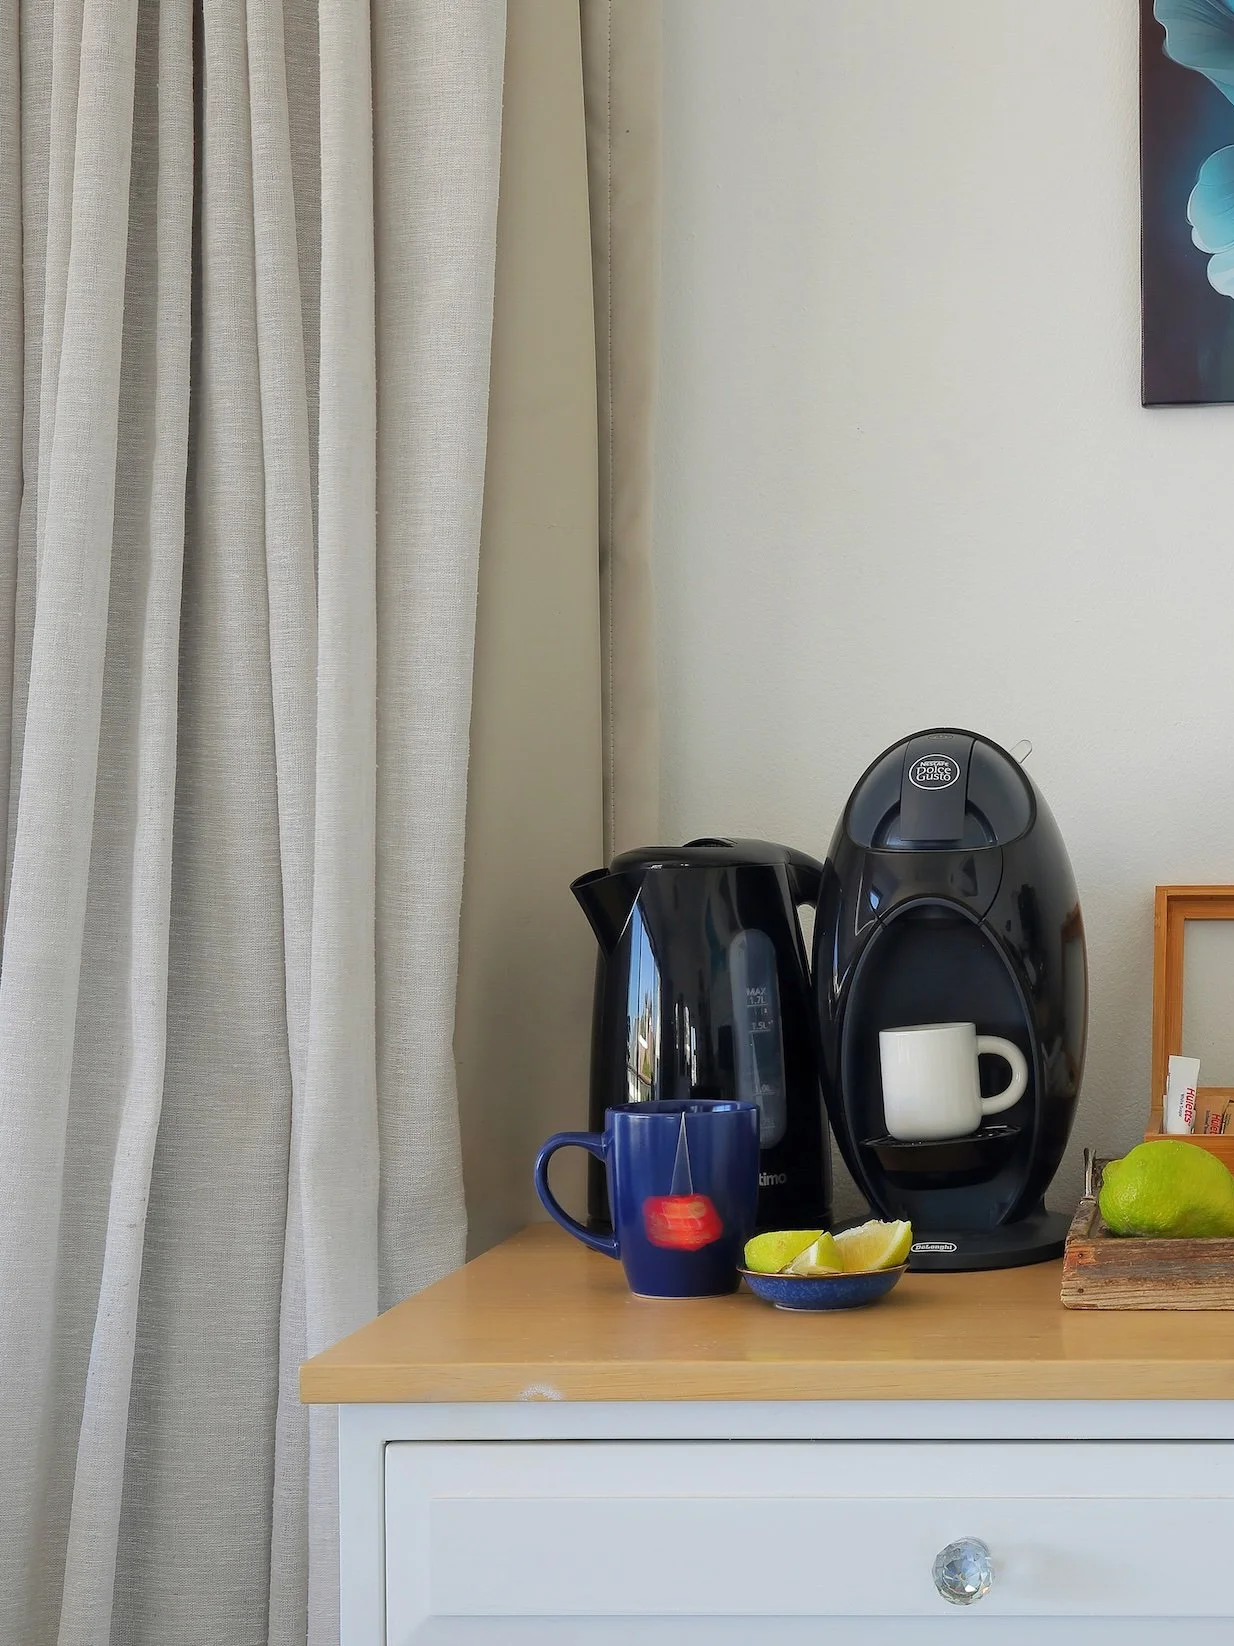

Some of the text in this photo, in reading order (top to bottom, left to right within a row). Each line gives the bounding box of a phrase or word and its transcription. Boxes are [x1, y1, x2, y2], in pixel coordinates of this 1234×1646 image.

[916, 765, 952, 775] Dolce
[916, 772, 951, 782] Gusto
[746, 987, 767, 996] MAX
[1183, 1087, 1196, 1124] Huletts
[758, 1172, 787, 1187] timo
